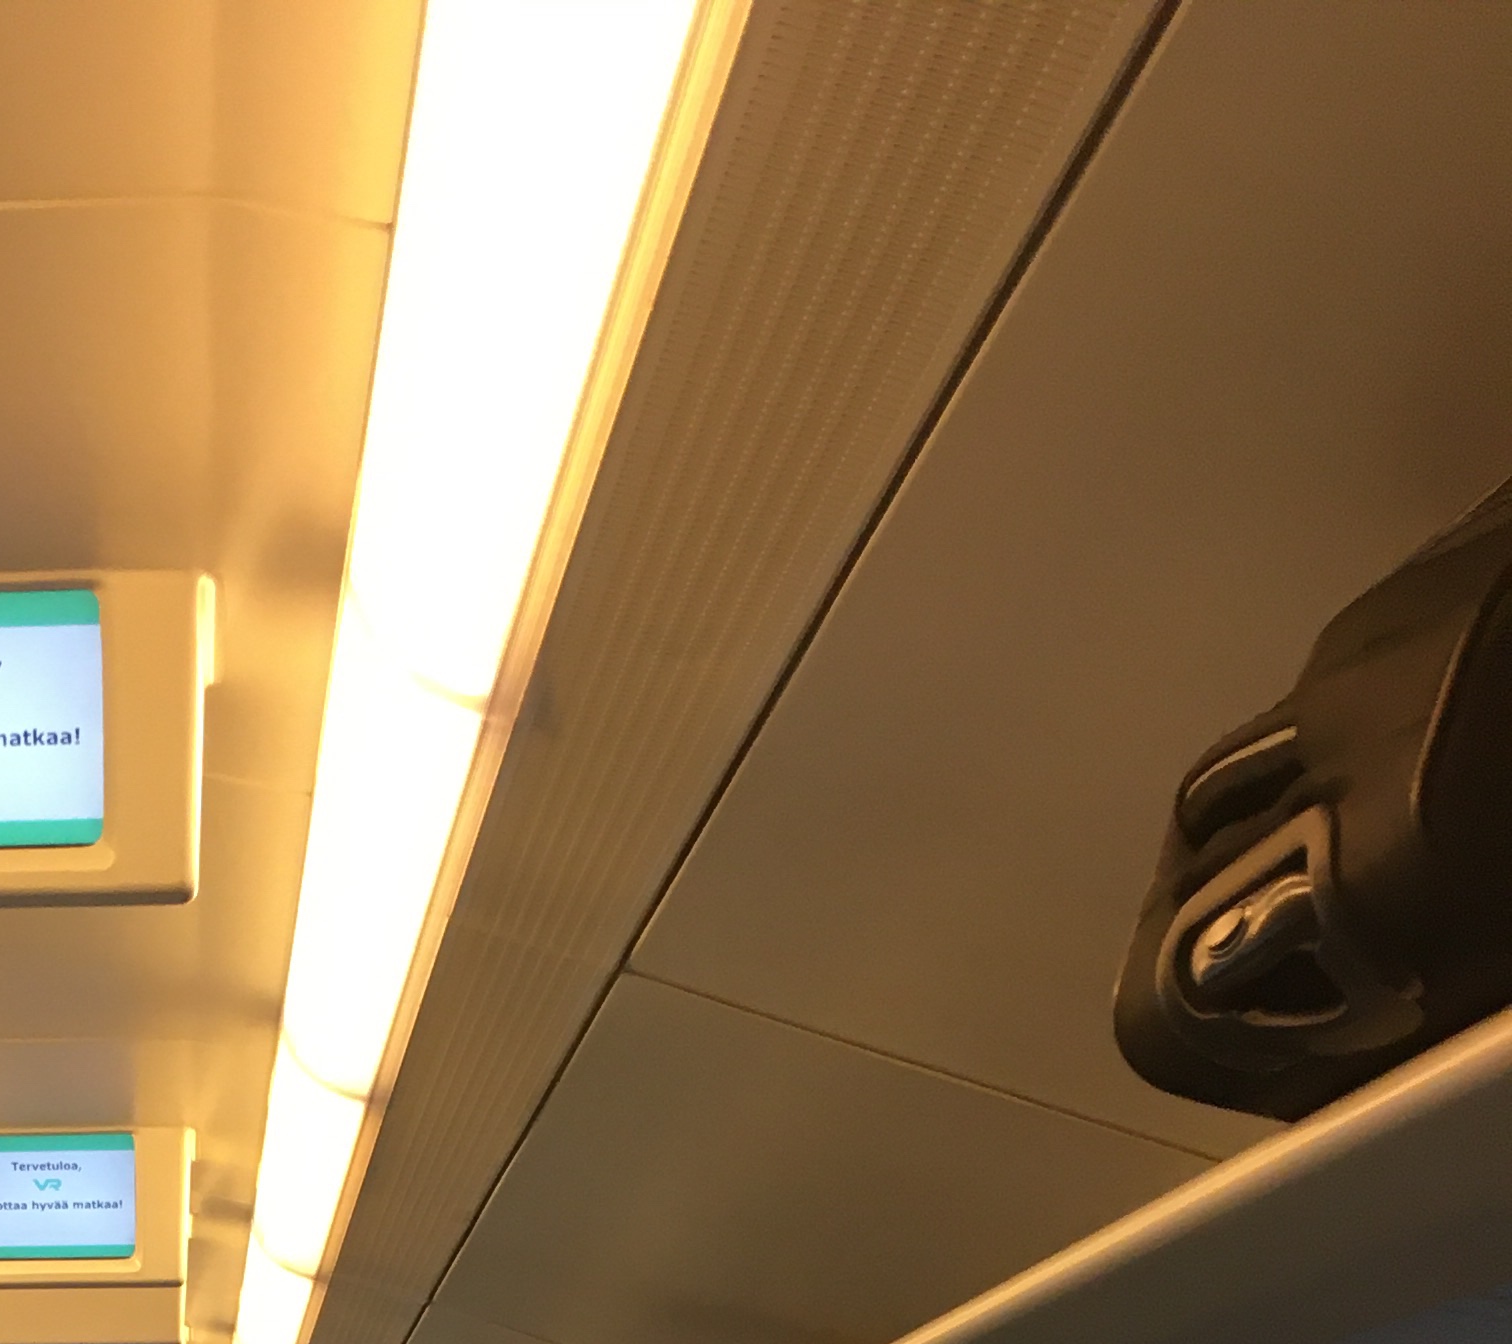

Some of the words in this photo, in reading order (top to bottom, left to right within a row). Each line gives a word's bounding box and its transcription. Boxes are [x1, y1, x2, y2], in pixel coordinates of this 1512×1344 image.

[11, 1161, 83, 1172] Tervetuloa,
[33, 1178, 62, 1191] VR
[31, 1200, 69, 1212] hyvää
[73, 1199, 123, 1210] matkaa!
